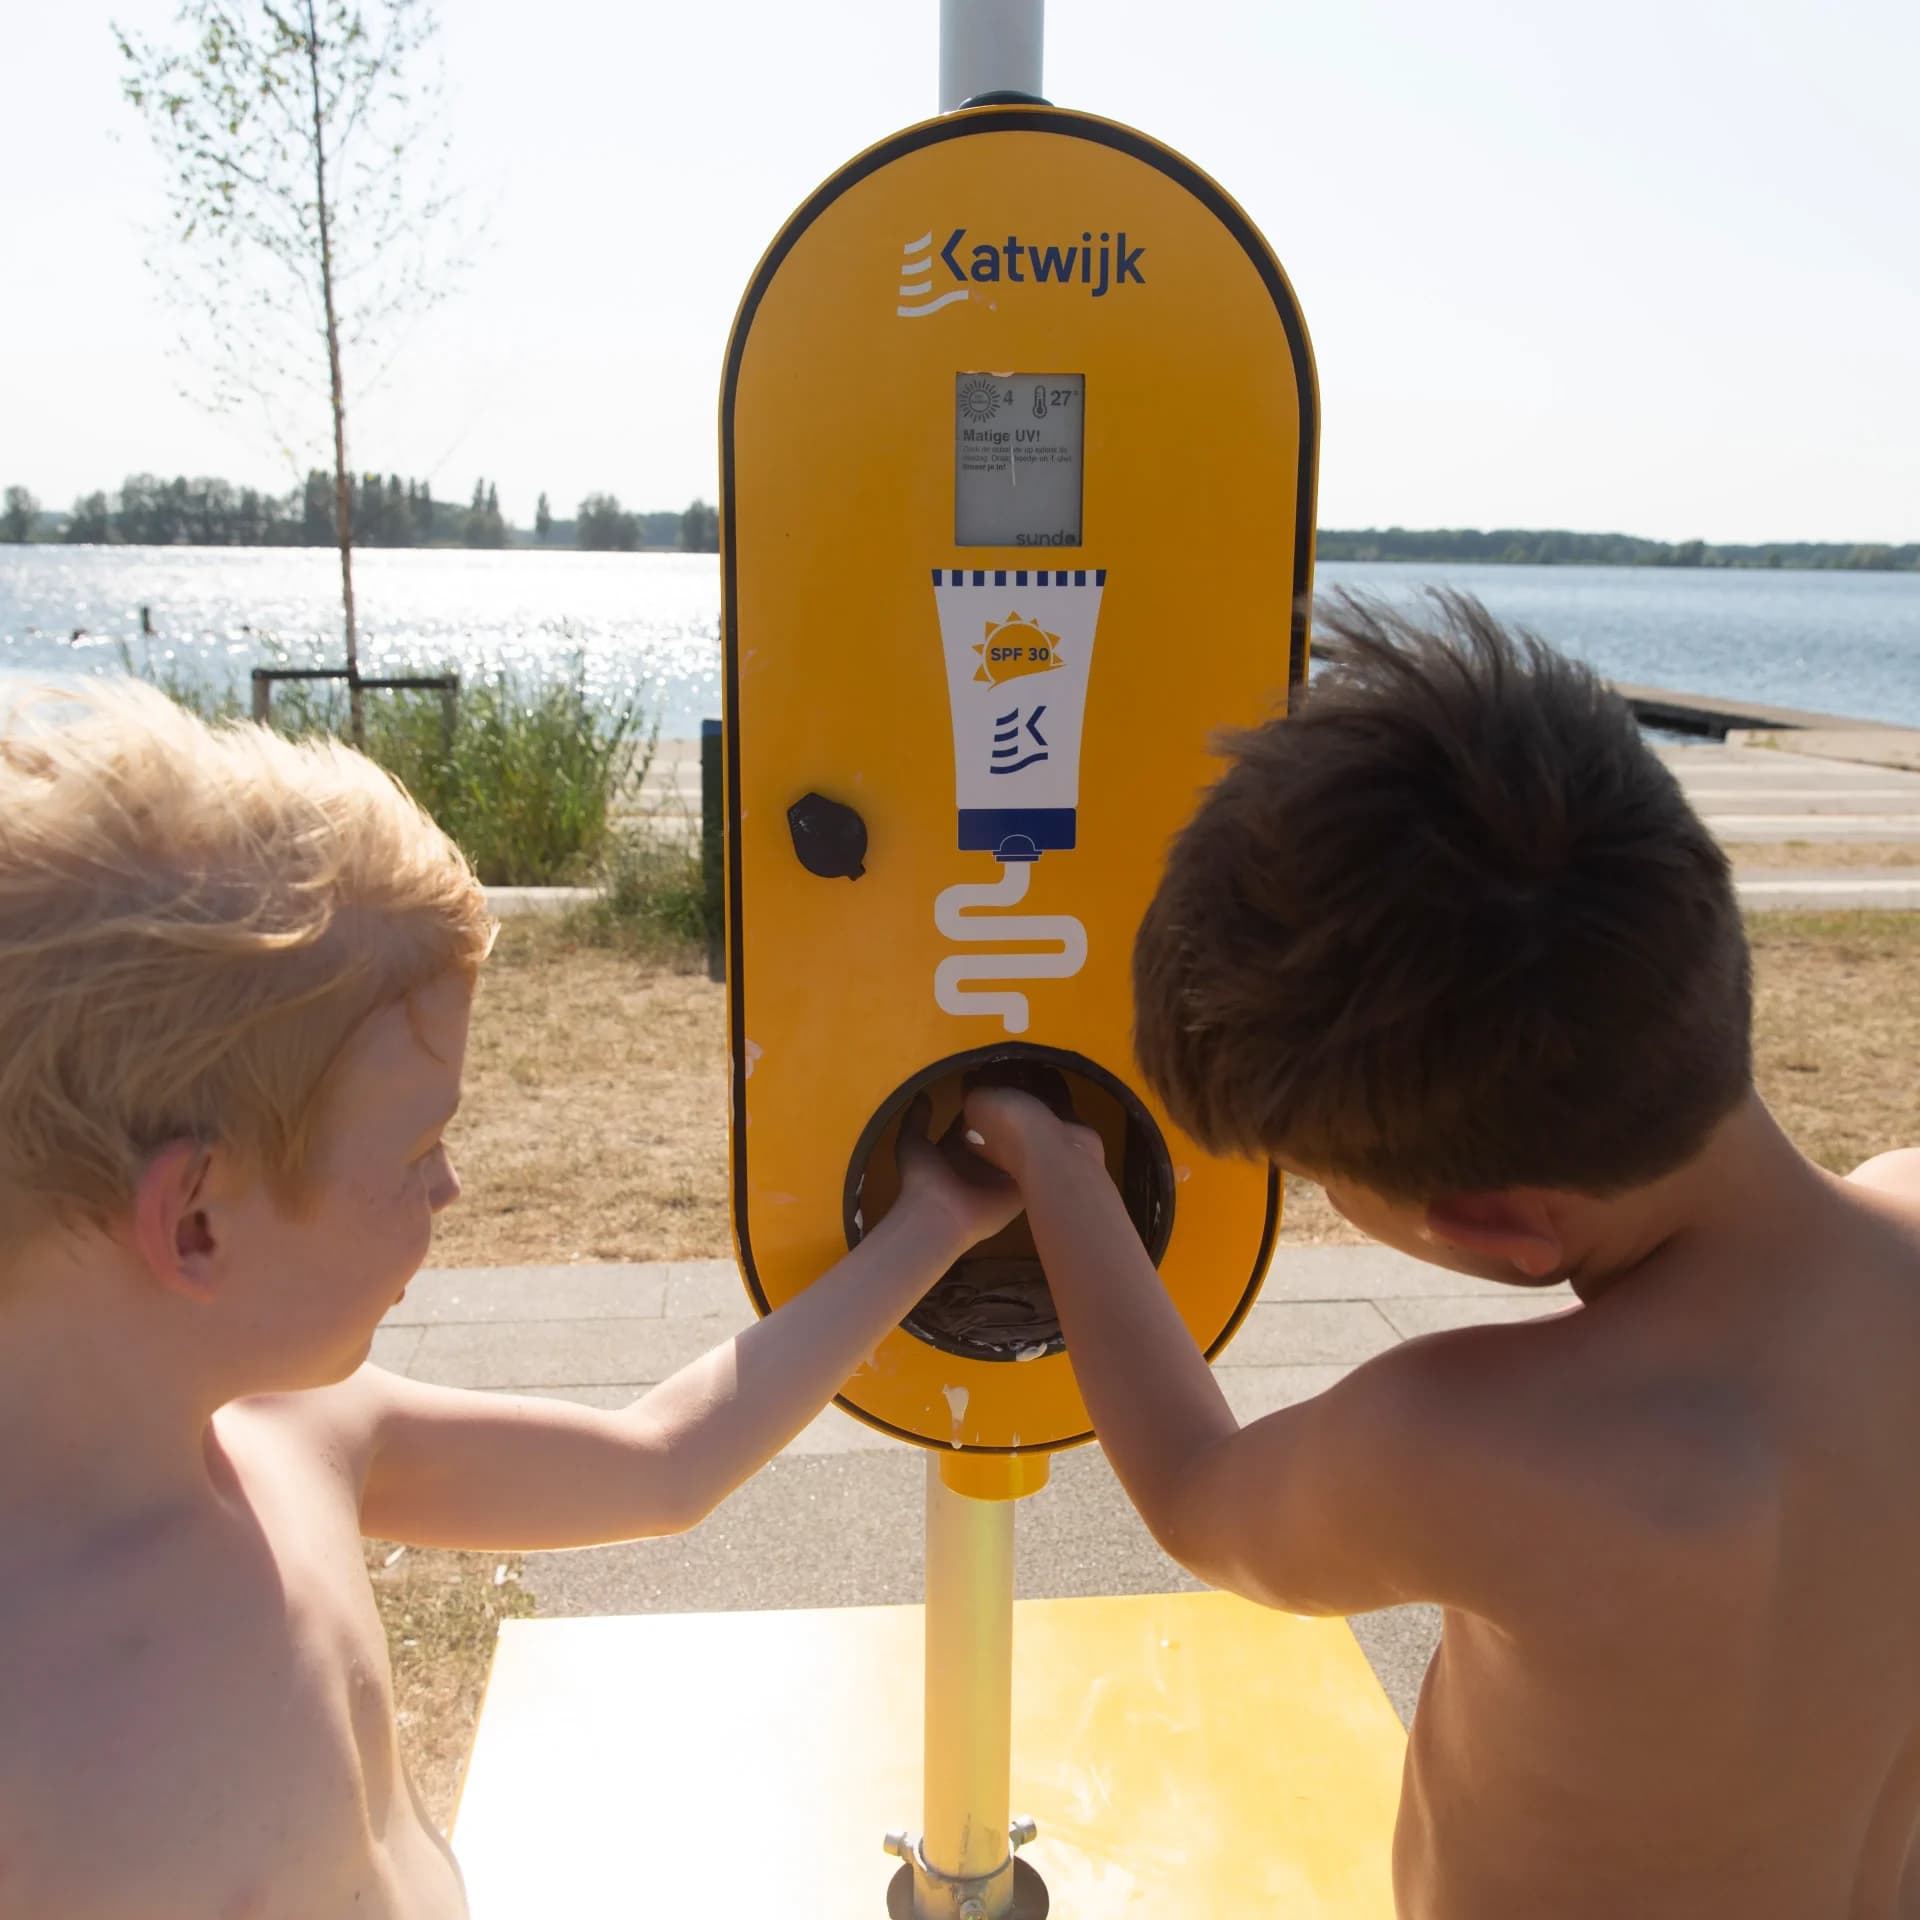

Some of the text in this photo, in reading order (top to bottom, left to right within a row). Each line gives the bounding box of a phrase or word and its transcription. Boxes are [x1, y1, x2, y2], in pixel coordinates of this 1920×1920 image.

[940, 229, 1146, 297] Katwijk
[1003, 389, 1013, 406] 4
[963, 429, 1040, 445] Matige UV!
[991, 648, 1049, 661] SPF 30
